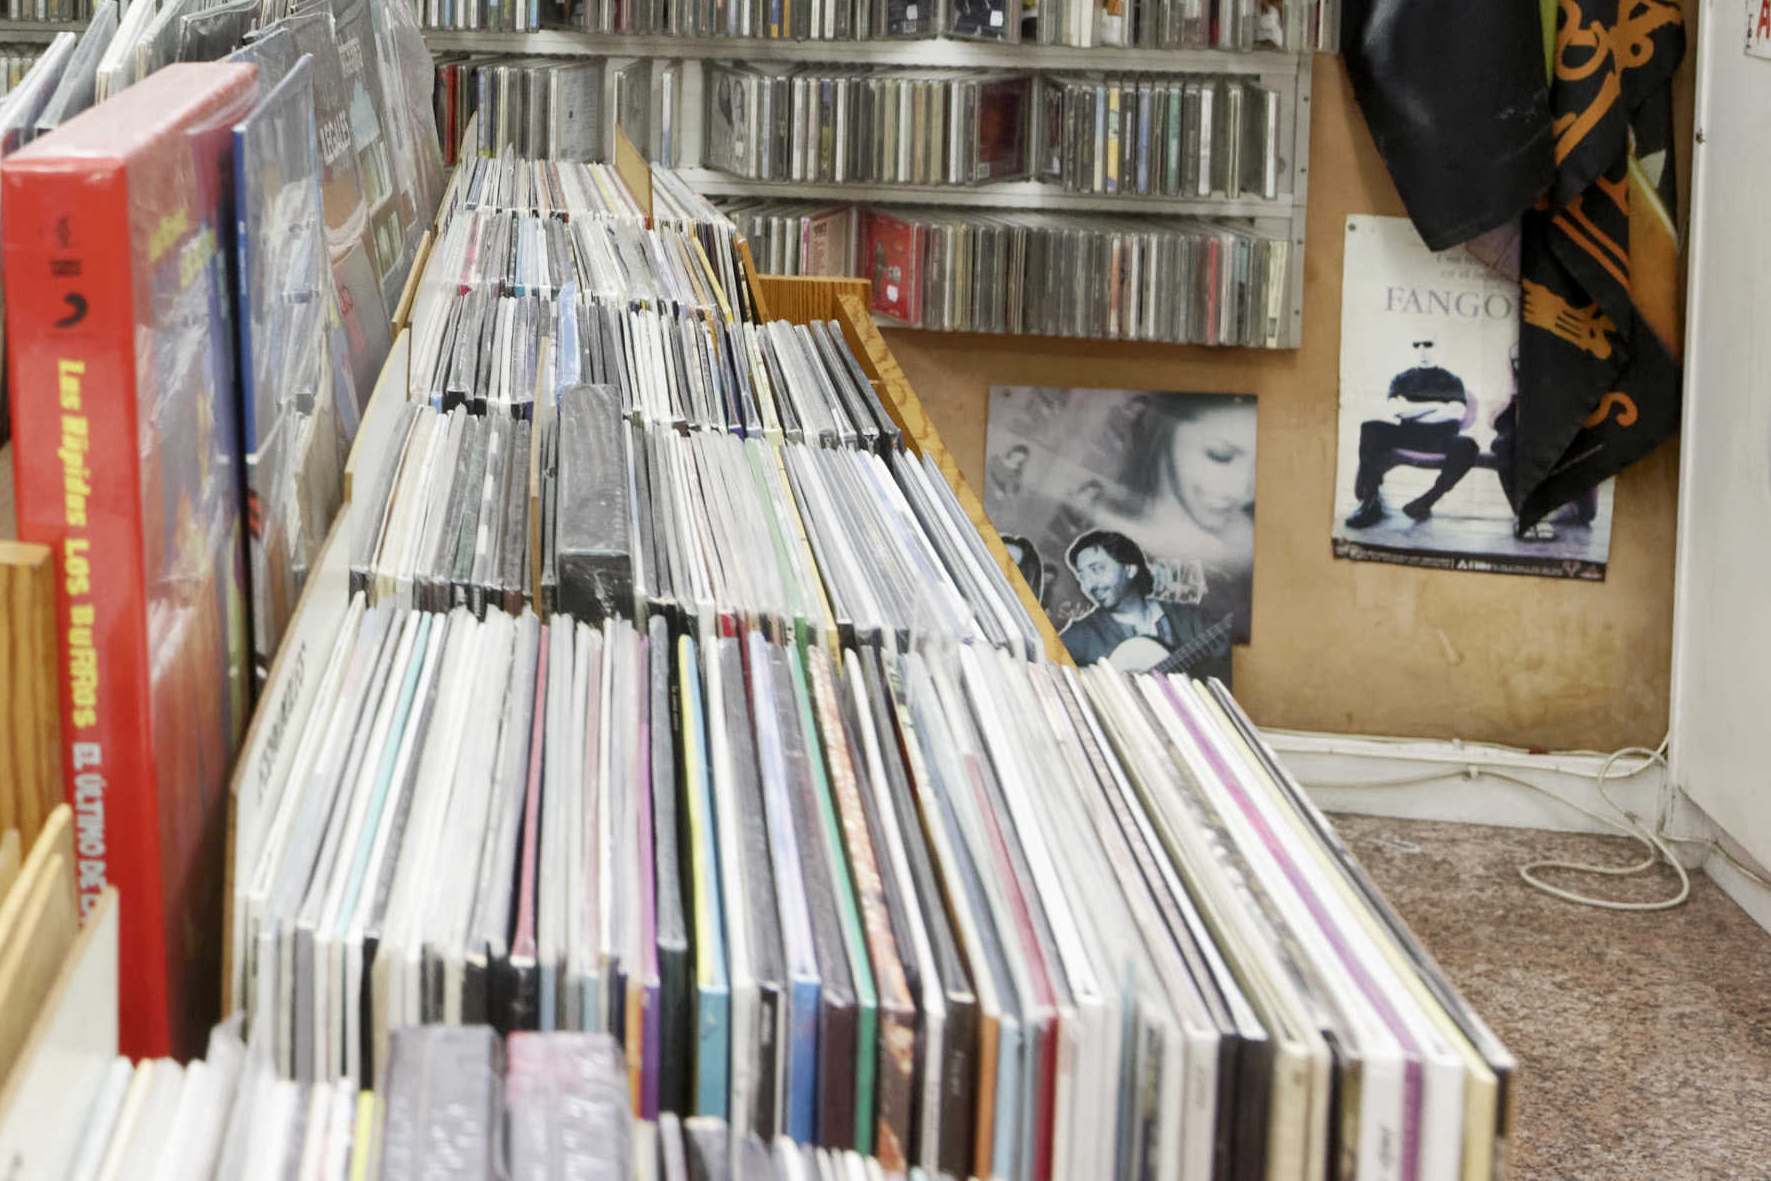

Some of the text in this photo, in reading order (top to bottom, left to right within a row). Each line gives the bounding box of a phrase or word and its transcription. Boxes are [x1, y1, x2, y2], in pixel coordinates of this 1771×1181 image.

[64, 537, 91, 597] LOS
[68, 604, 99, 729] BURROS
[72, 741, 103, 770] EL
